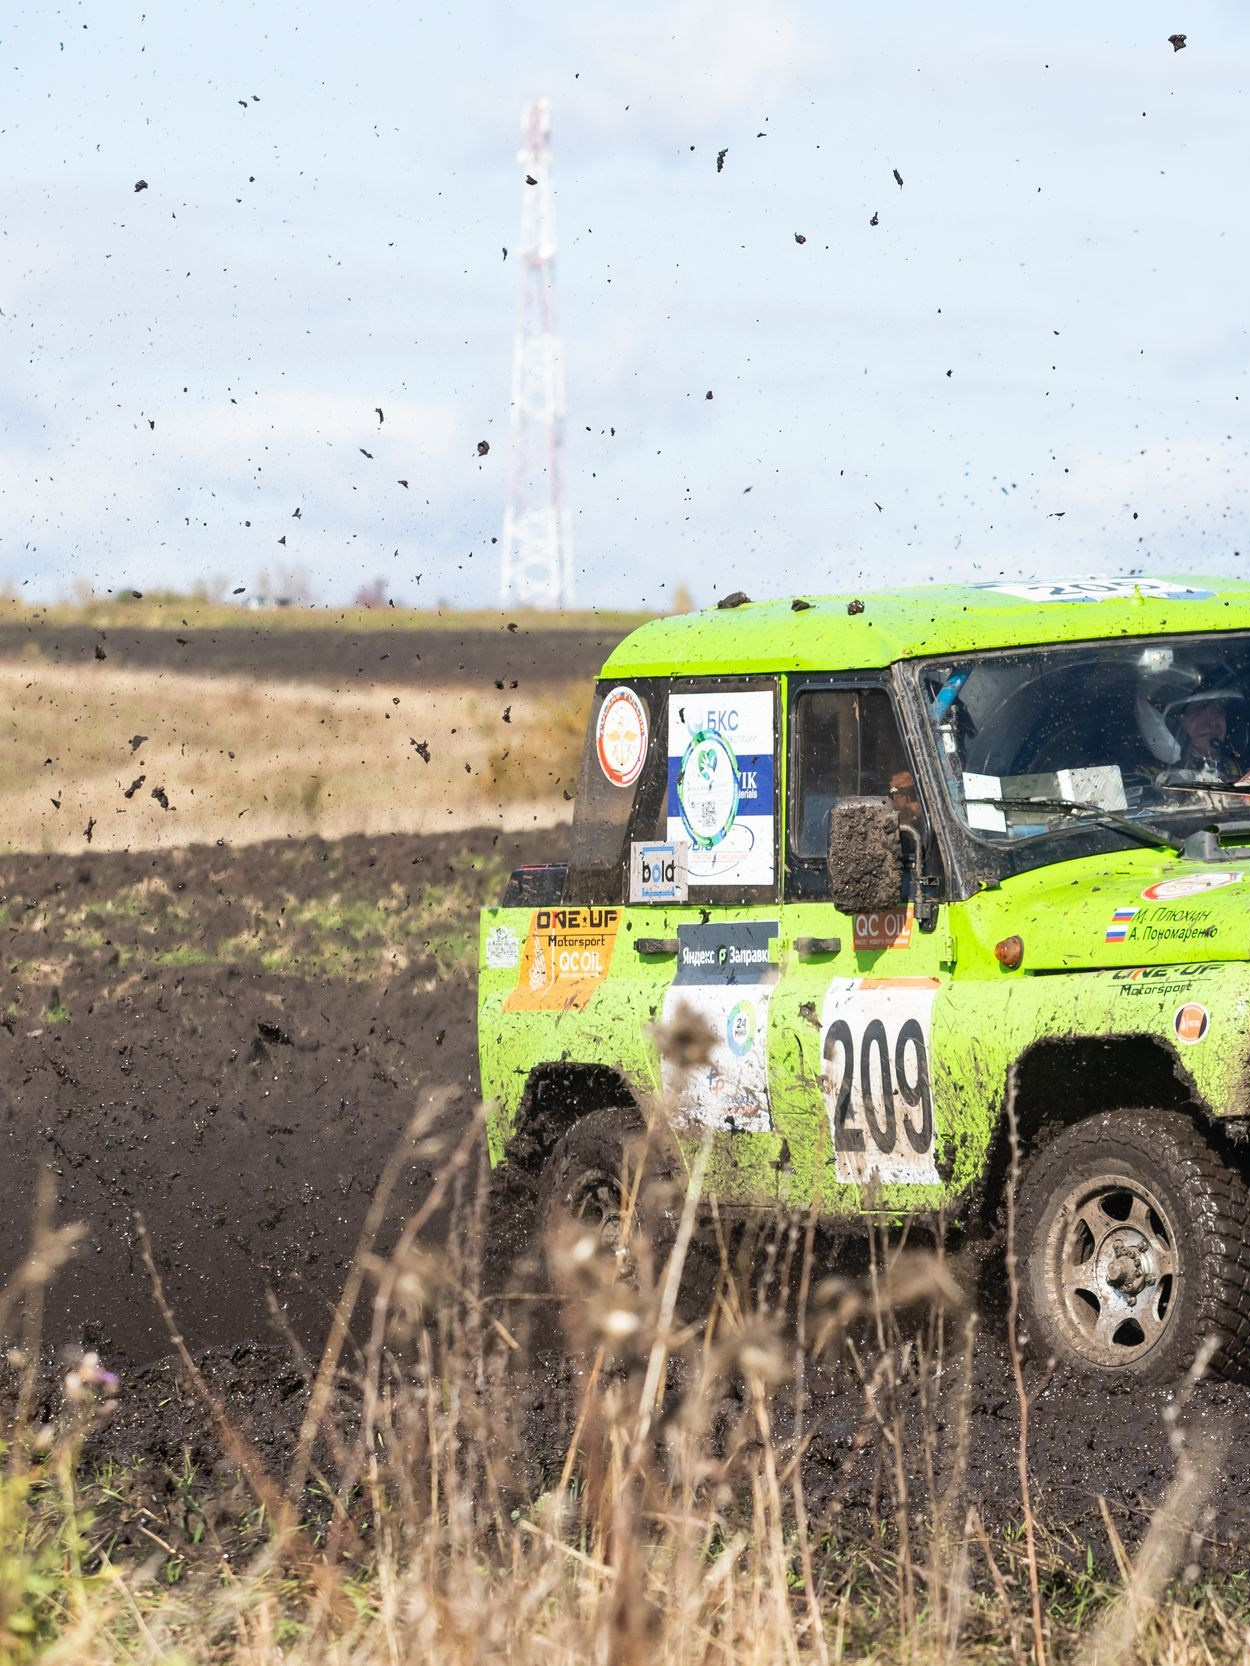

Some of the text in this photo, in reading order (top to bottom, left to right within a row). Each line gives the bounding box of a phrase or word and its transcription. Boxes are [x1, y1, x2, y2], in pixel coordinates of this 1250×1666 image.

[707, 710, 739, 731] БКС
[642, 860, 675, 883] bold
[536, 910, 581, 929] ONE
[856, 913, 911, 937] QC OIL
[548, 935, 606, 949] Motorsport
[1128, 926, 1218, 943] А. Пономаренко
[559, 951, 603, 972] QC OIL
[682, 945, 769, 967] Яндекс Заправк
[1119, 981, 1193, 997] Motorsport
[736, 1018, 747, 1029] 24
[823, 1018, 933, 1155] 209
